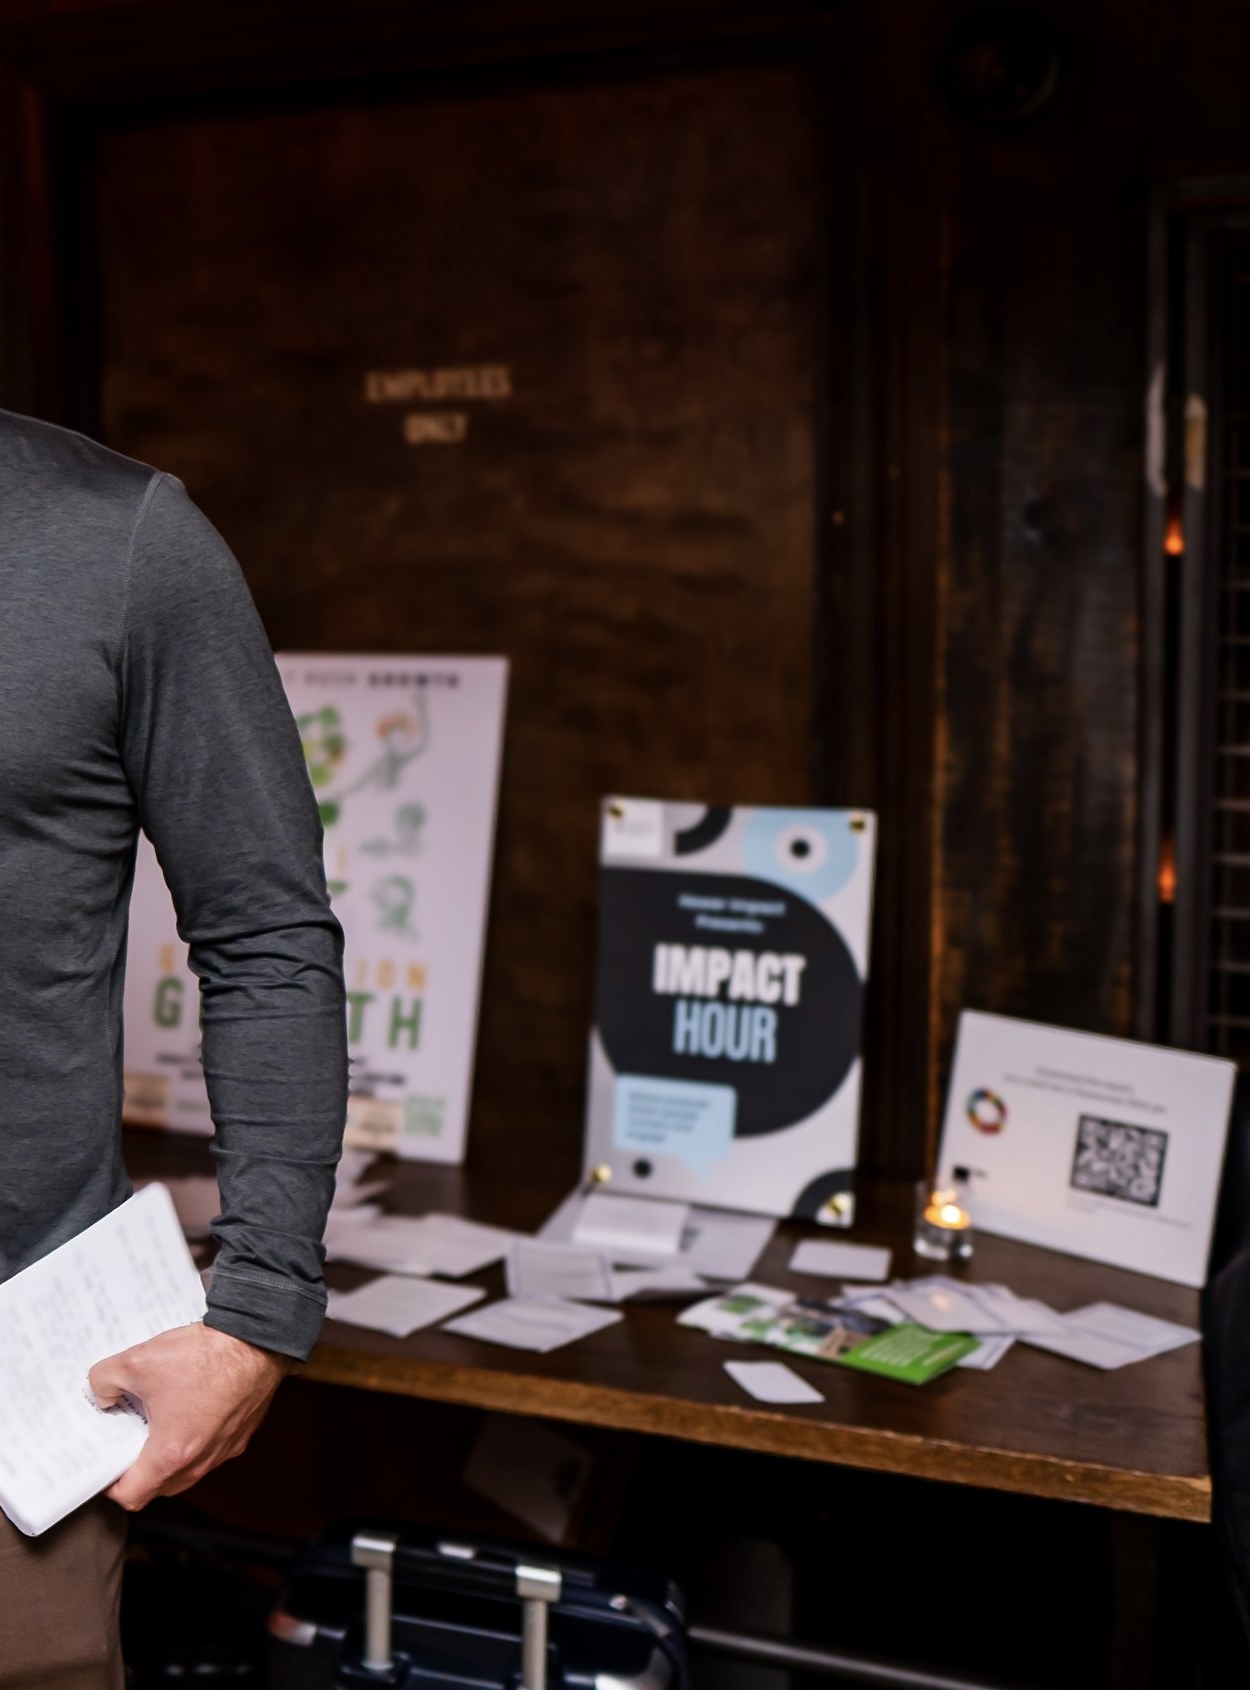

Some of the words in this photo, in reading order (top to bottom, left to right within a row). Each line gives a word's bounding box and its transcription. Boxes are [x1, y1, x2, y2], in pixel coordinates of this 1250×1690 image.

[366, 366, 511, 402] EMPLOYEES
[405, 413, 467, 444] ONLY
[653, 942, 807, 1006] IMPACT
[673, 998, 778, 1064] HOUR
